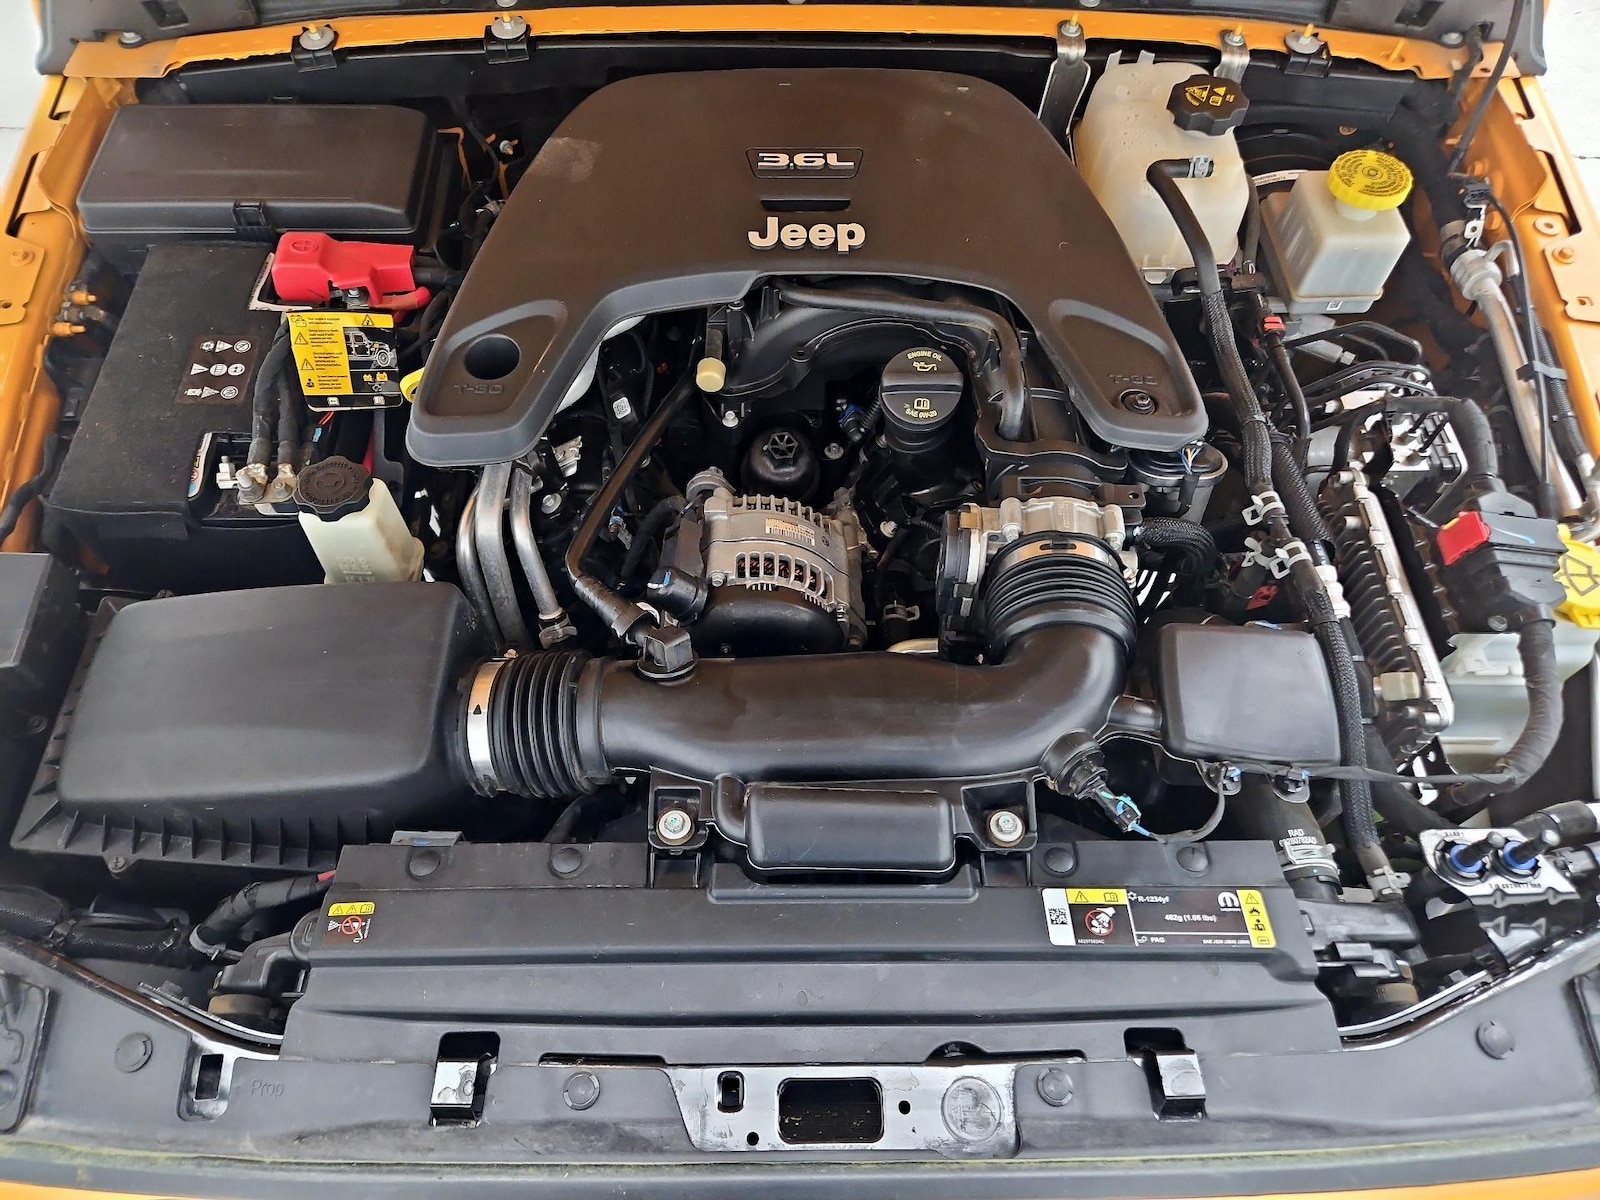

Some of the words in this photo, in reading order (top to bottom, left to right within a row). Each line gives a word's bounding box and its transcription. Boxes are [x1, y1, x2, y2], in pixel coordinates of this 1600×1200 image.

[757, 152, 855, 170] 3.6L
[747, 216, 866, 254] Jeep
[907, 350, 932, 360] ENGINE
[932, 353, 943, 362] OIL
[905, 408, 919, 418] SAE
[919, 410, 938, 419] 0W-20
[1287, 829, 1305, 838] RAD
[1137, 895, 1170, 905] R-1234yf
[1164, 914, 1183, 923] 482g
[1202, 914, 1218, 923] lbs)
[1150, 936, 1166, 944] PAG
[251, 1079, 285, 1101] Prop
